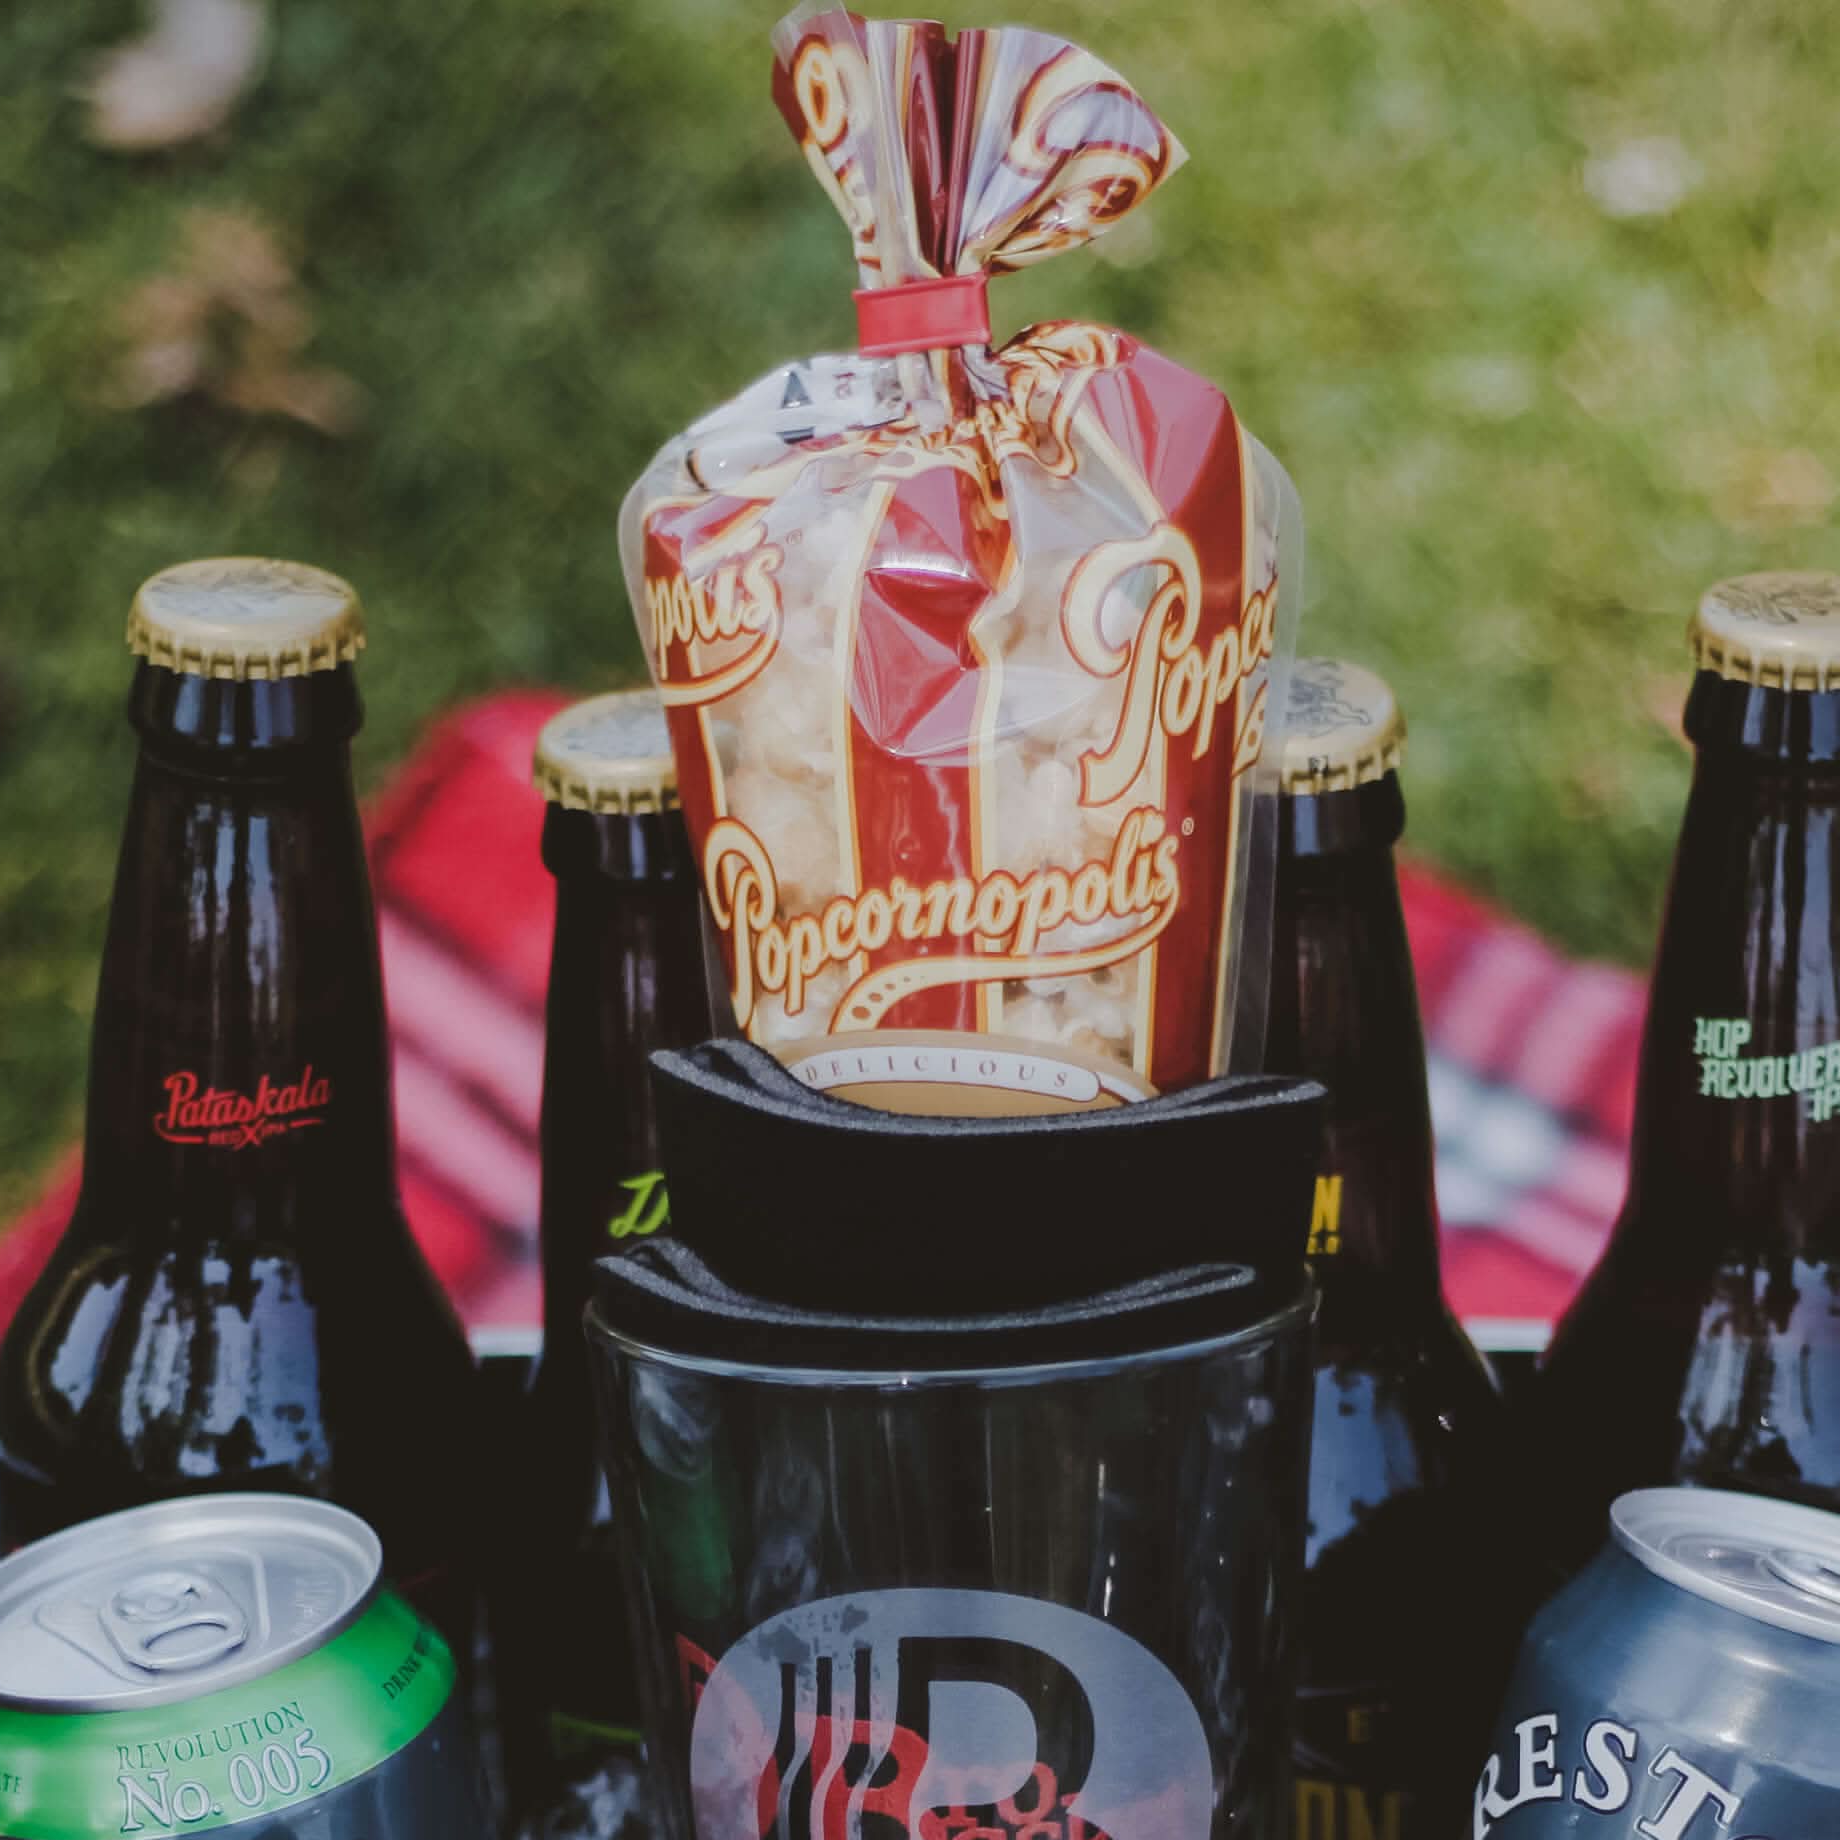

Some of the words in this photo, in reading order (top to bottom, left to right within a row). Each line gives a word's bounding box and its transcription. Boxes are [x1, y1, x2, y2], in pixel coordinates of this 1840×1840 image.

[703, 805, 1182, 1034] Popcornopolis
[1693, 1016, 1752, 1058] HOP
[162, 1064, 331, 1130] Pataskala
[803, 1055, 1068, 1088] DELICIOUS
[115, 1700, 306, 1770] REVOLUTION
[116, 1767, 225, 1835] No.
[228, 1726, 334, 1809] 005
